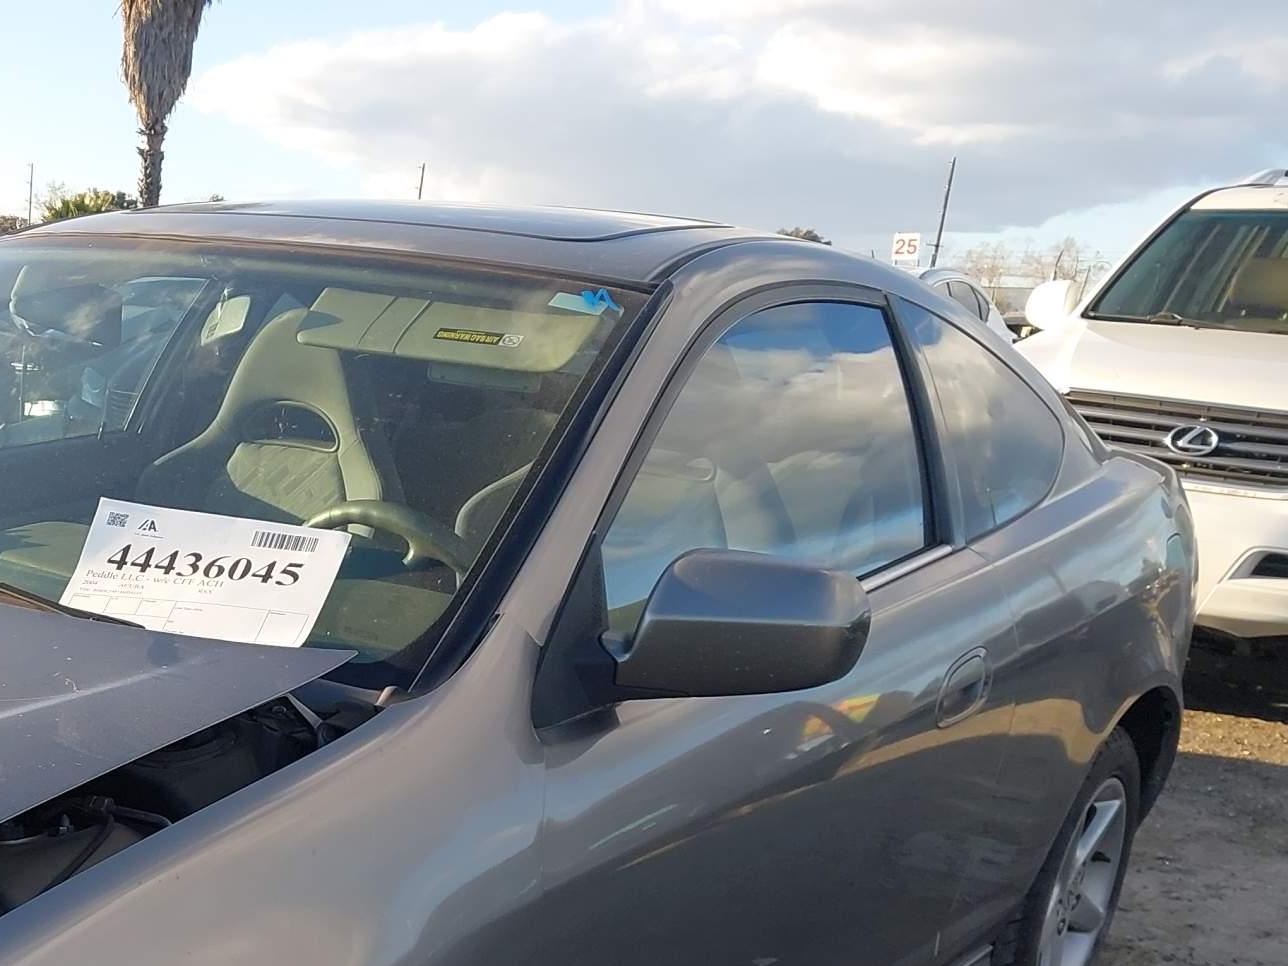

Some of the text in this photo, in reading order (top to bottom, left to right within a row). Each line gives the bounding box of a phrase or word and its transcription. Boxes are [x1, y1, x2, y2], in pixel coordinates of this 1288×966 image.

[894, 238, 918, 255] 25
[107, 543, 306, 586] 44436045
[85, 569, 119, 580] Peddle
[120, 573, 145, 582] LLC
